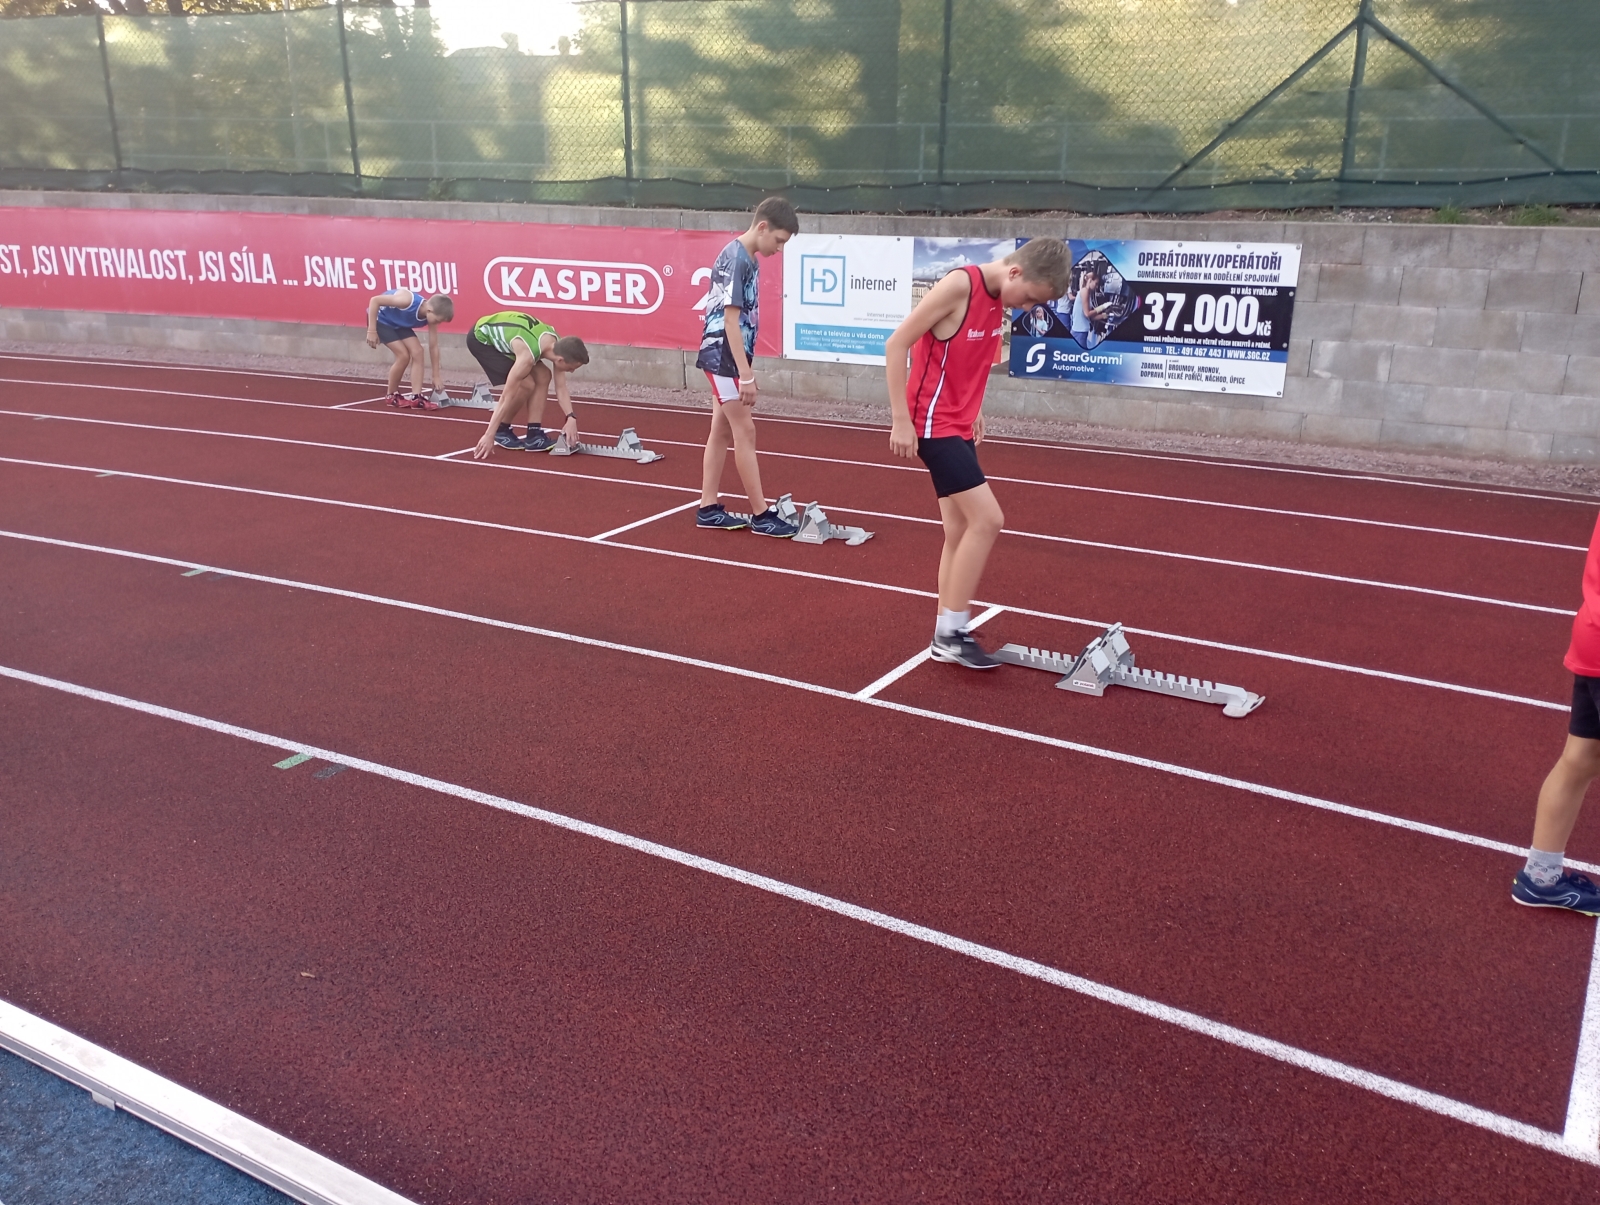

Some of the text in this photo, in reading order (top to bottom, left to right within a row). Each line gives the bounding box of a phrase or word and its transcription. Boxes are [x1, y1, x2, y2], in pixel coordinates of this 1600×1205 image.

[1138, 249, 1282, 270] OPERÁTORKY/OPERÁTOŘI
[31, 245, 59, 275] JSI
[61, 246, 194, 285] VYTRVALOST,
[198, 251, 227, 283] JSI
[229, 246, 277, 285] SÍLA
[303, 255, 357, 290] JSME
[363, 258, 377, 291] S
[380, 259, 459, 295] TEBOU!
[1137, 270, 1280, 283] GUMÁRENSKÉ VÝROBY NA ODDĚLENÍ SPOJOVÁNÍ
[500, 266, 649, 305] KASPER
[810, 268, 838, 293] HD
[850, 275, 897, 291] internet
[1241, 287, 1252, 295] NÁS
[1143, 292, 1260, 336] 37.000
[800, 328, 823, 336] Internet
[867, 332, 885, 340] doma
[1053, 350, 1123, 365] SaarGummi
[1165, 345, 1180, 355] TEL.:
[1181, 347, 1193, 356] 491
[1194, 347, 1207, 357] 467
[1208, 348, 1221, 358] 443
[1052, 363, 1095, 373] Automotive
[1141, 362, 1163, 370] ZDARMA
[1140, 370, 1164, 378] DOPRAVA
[1167, 372, 1183, 380] VELKÉ
[1229, 375, 1246, 385] ÚPICE
